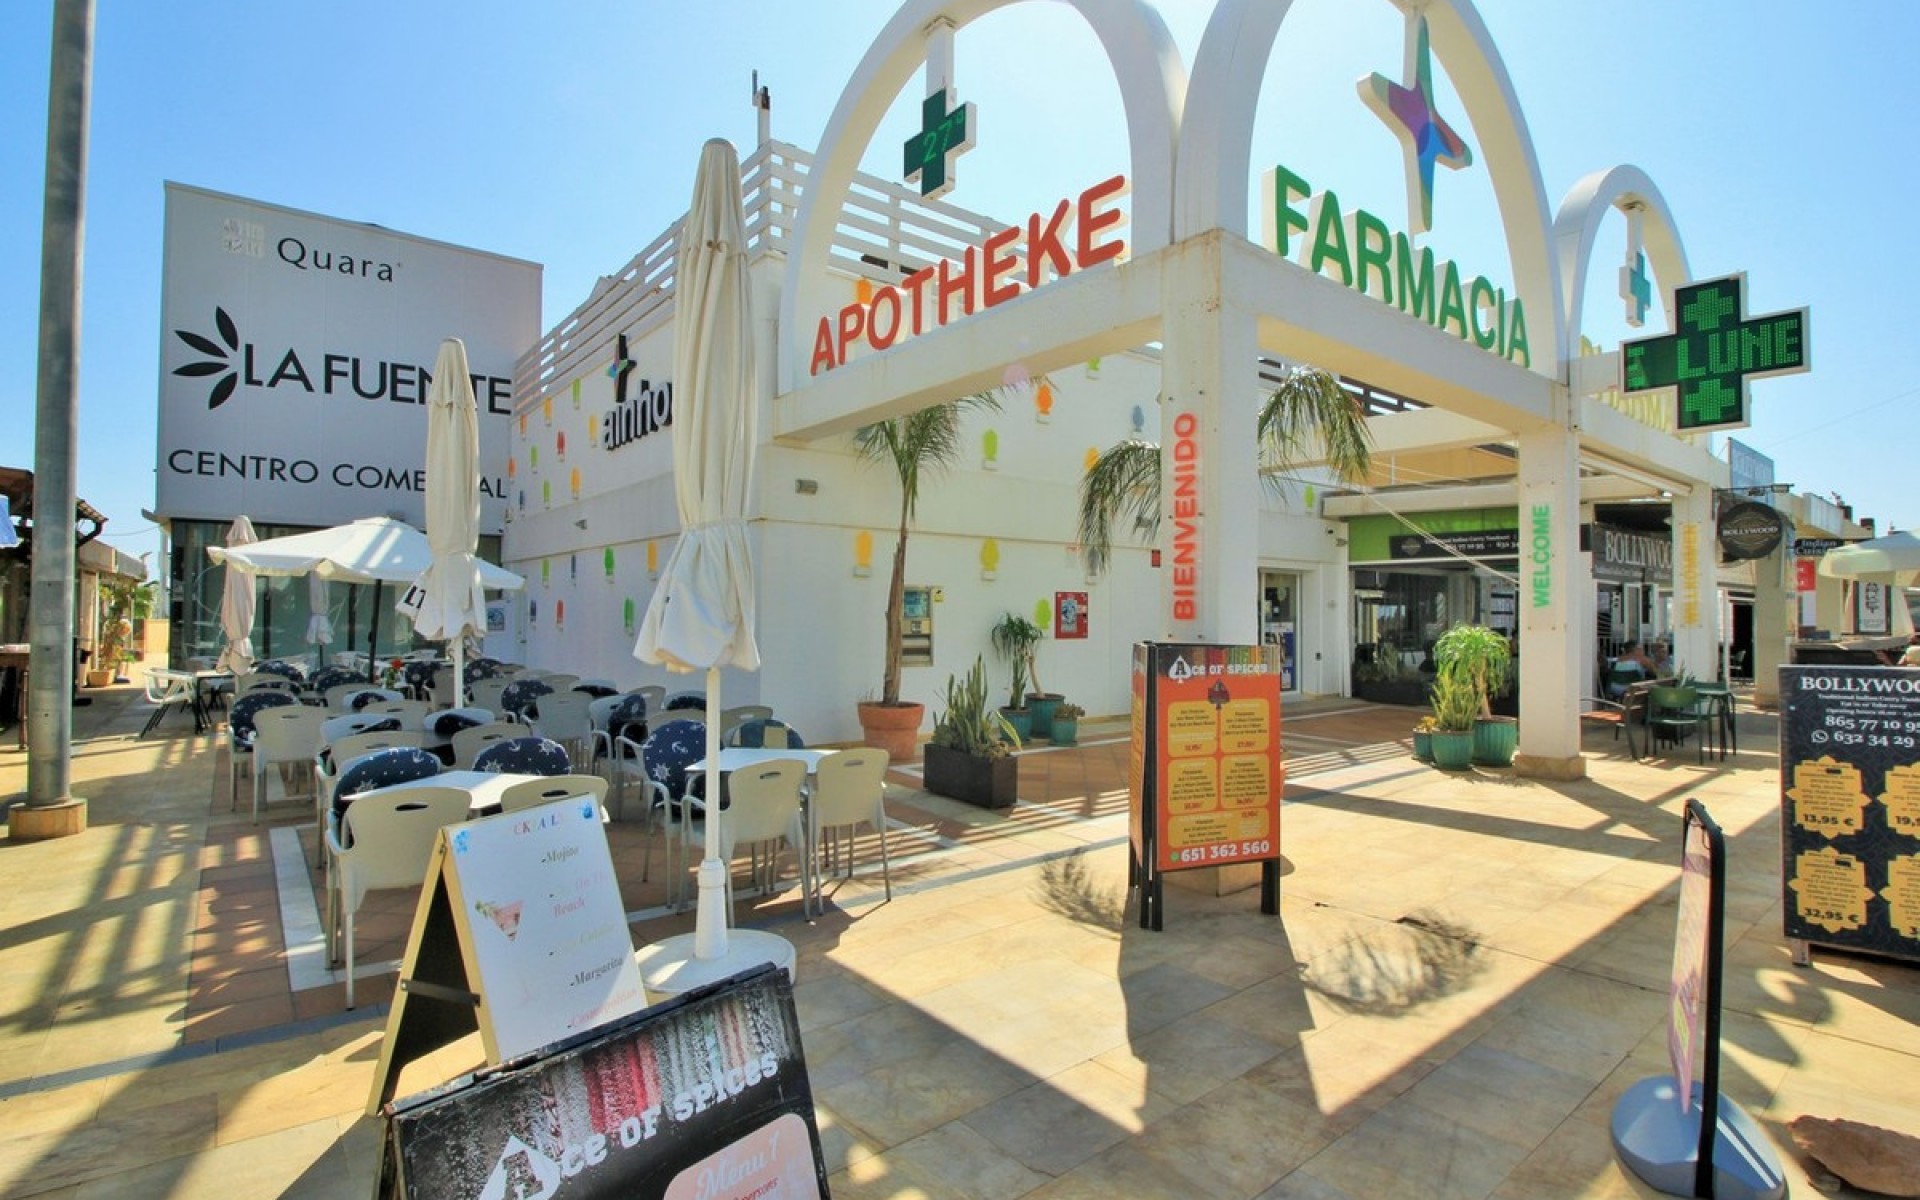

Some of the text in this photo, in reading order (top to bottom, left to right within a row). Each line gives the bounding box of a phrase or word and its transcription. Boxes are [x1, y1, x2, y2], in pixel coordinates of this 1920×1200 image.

[277, 237, 393, 282] Quara
[810, 174, 1126, 376] APOTHEKE
[1273, 164, 1531, 370] FARMACIA
[244, 342, 314, 393] LA
[603, 379, 673, 451] ainho
[168, 449, 508, 500] CENTRO COMEAL
[1173, 412, 1197, 621] BIENVENIDO
[1532, 503, 1552, 609] WELCOME
[1606, 530, 1672, 569] BOLLYWOO
[1825, 715, 1856, 730] 865
[1859, 719, 1878, 731] 77
[1882, 720, 1901, 729] 10
[1833, 730, 1915, 748] 632 34 29
[1181, 840, 1270, 863] 651 362 560
